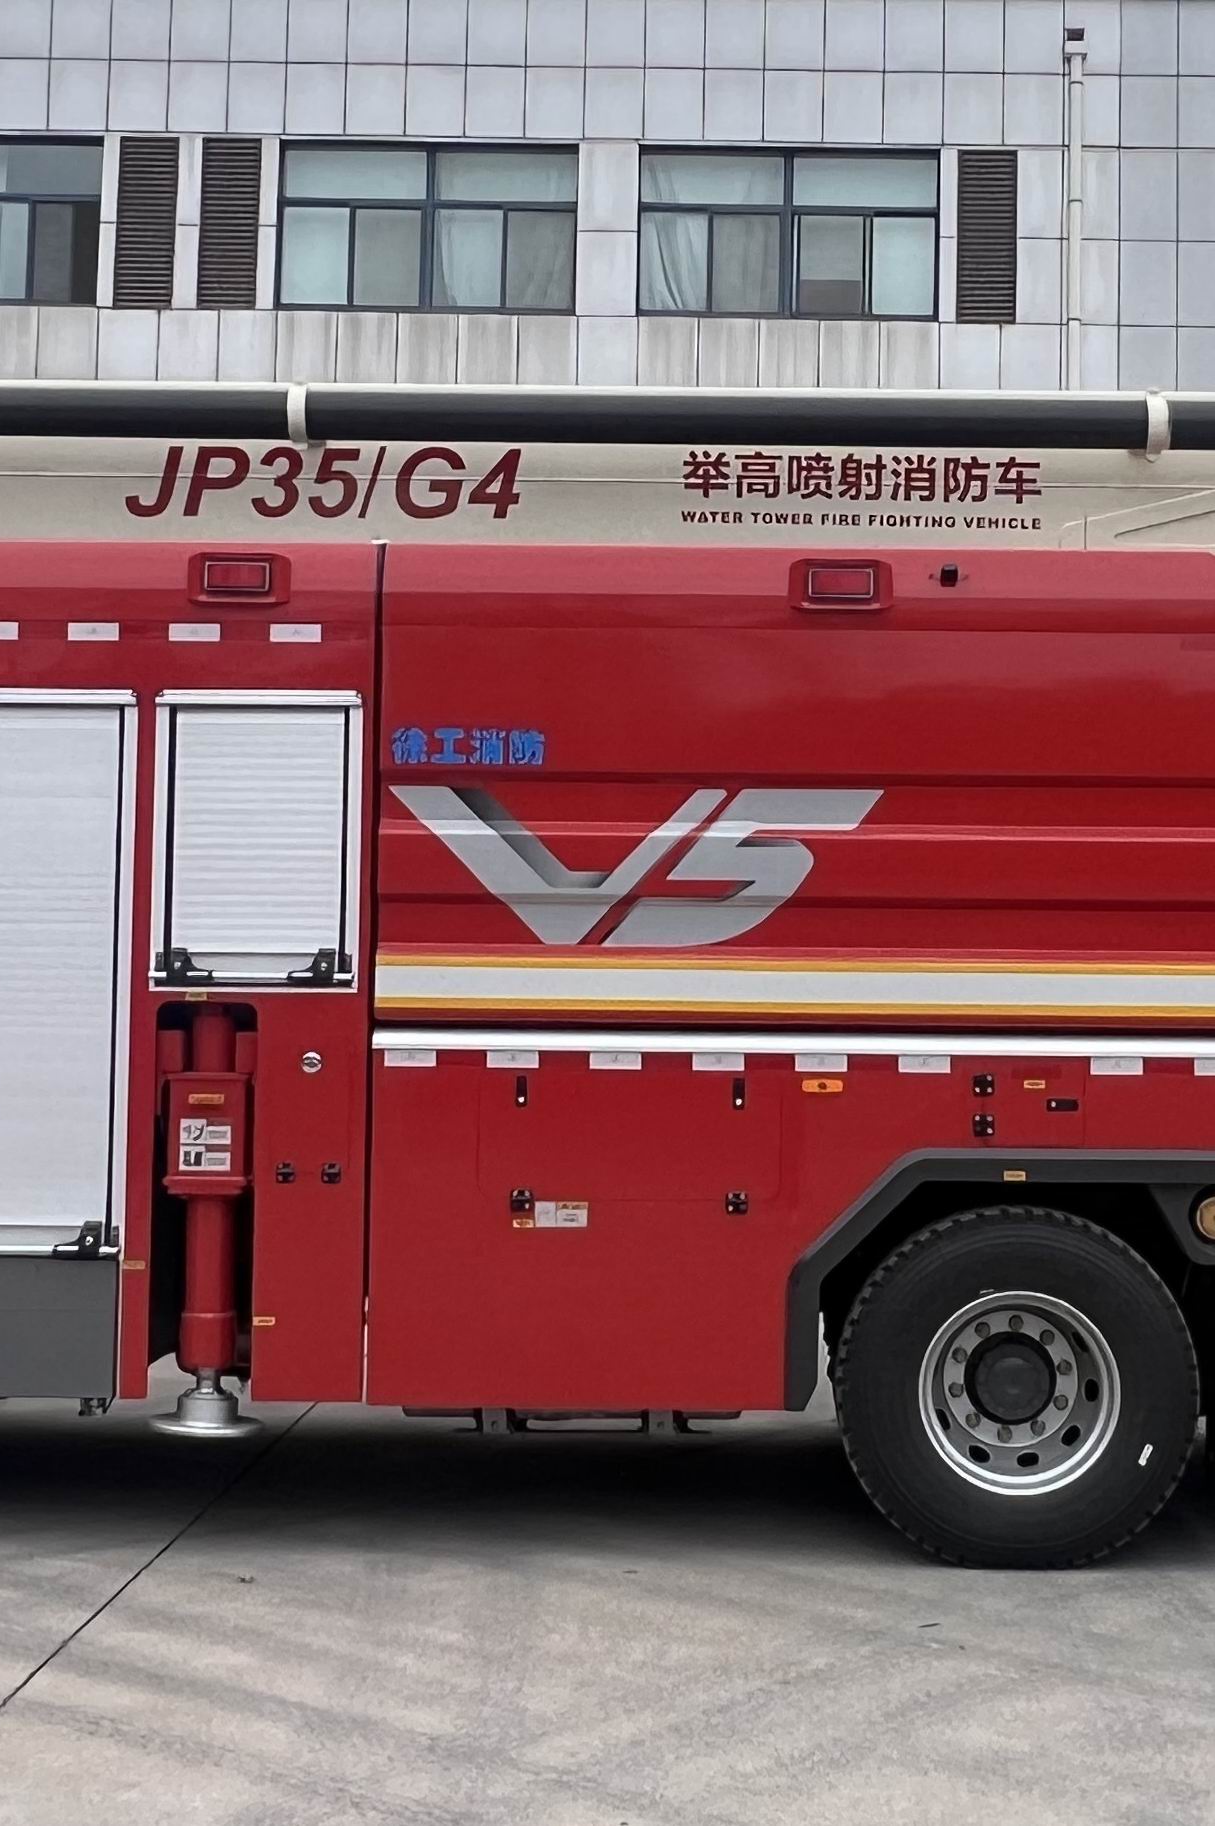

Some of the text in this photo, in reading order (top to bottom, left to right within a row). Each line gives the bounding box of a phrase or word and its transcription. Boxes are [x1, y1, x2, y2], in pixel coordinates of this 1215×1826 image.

[125, 446, 521, 519] JP35/G4
[682, 450, 1042, 502] 举高喷射消防车
[681, 511, 1041, 530] WATER TOWER FIRE FIGHTING VEHICLE
[391, 727, 545, 765] 徐工消防
